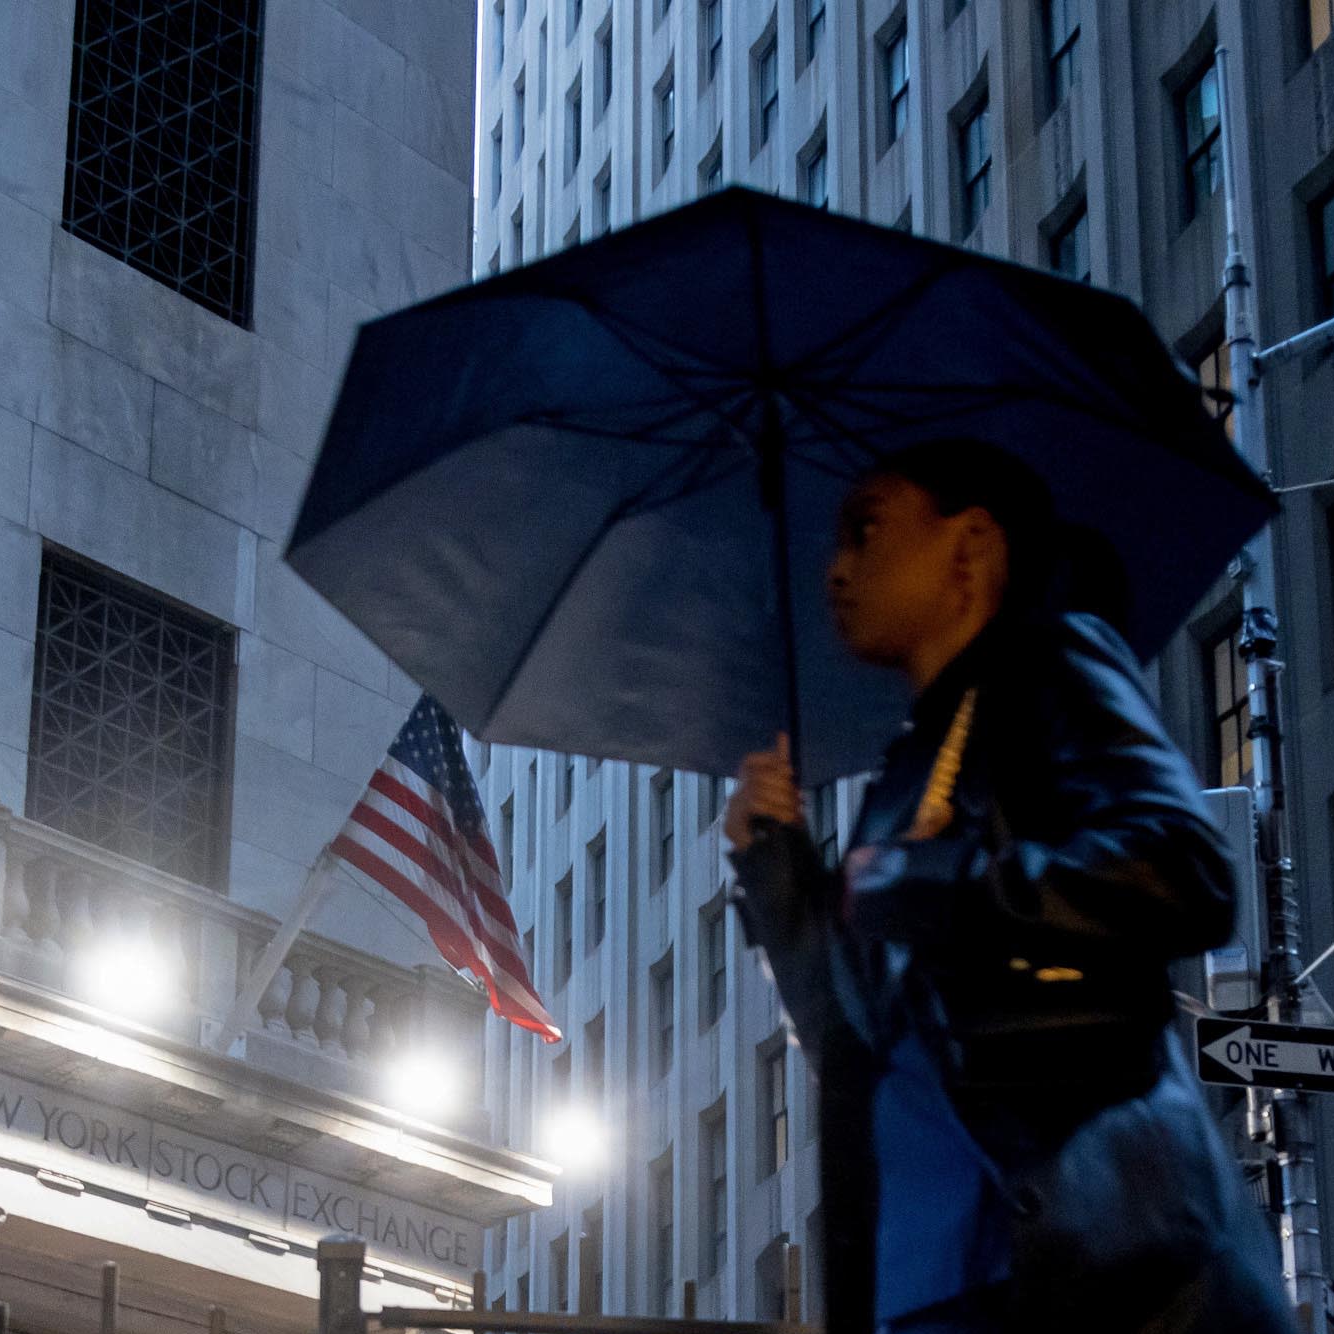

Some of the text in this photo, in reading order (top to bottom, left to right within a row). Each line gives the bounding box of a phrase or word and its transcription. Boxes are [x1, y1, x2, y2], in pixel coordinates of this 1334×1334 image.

[1226, 1040, 1279, 1068] ONE
[34, 1098, 139, 1169] YORK
[154, 1139, 272, 1208] STOCK
[292, 1182, 468, 1266] EXCHANGE
